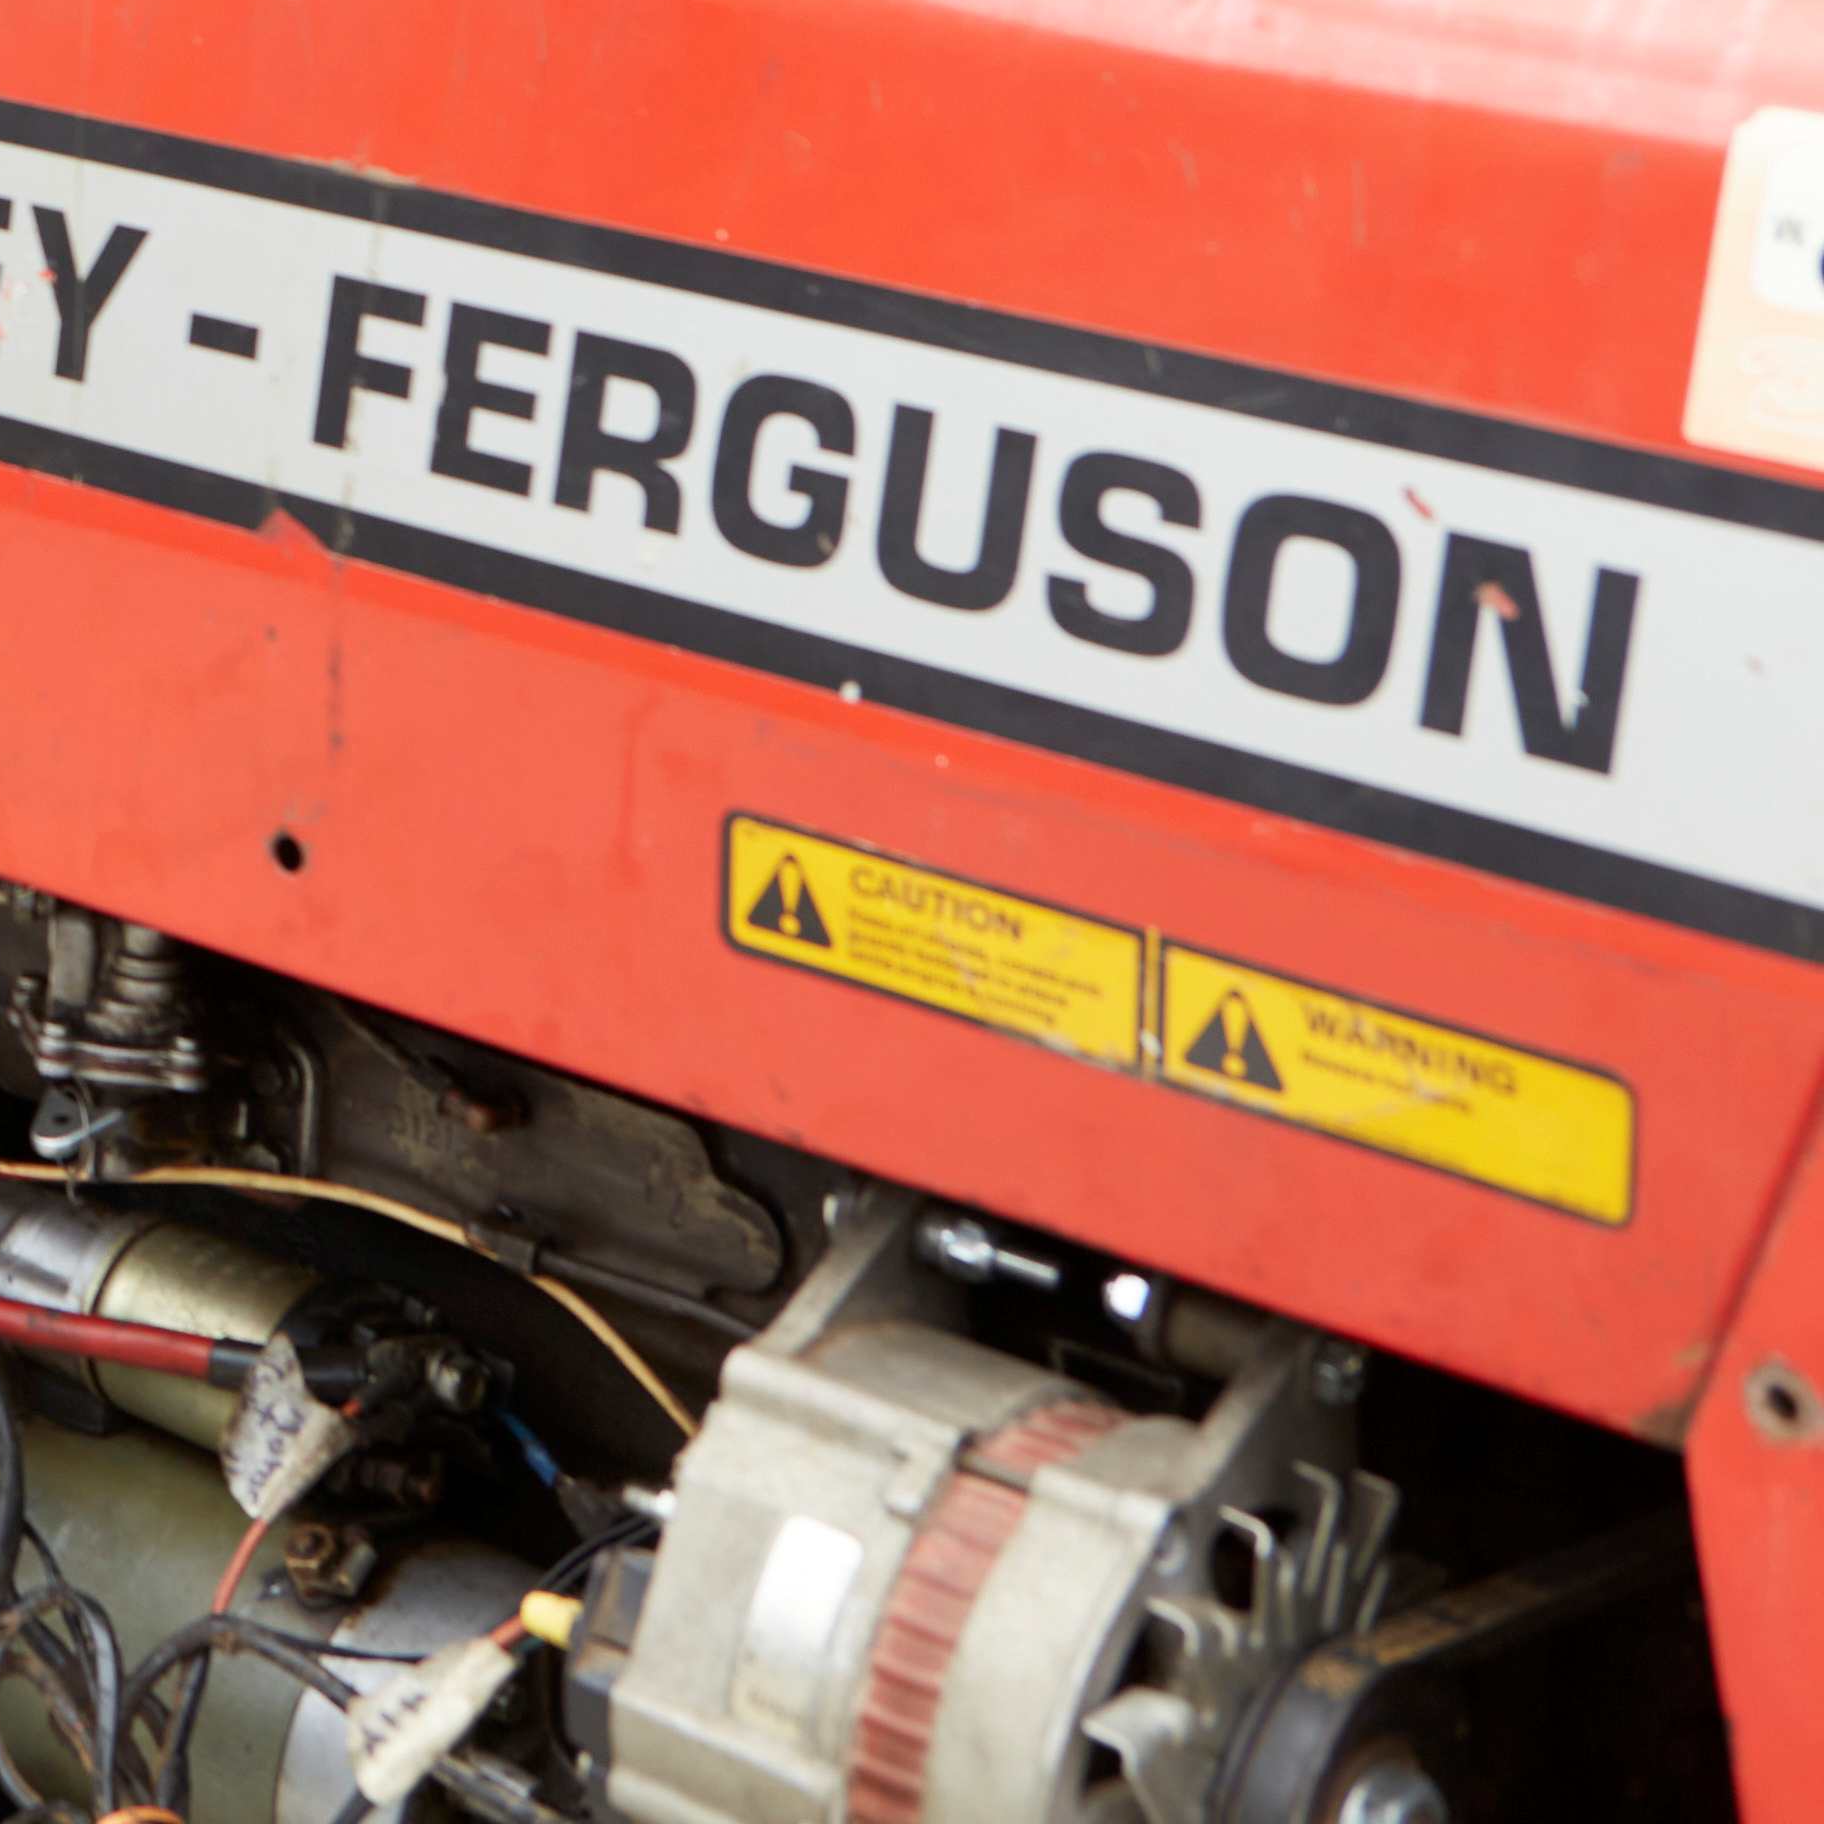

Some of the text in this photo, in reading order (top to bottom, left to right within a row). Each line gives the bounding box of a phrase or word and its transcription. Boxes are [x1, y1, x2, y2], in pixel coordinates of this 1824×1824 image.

[312, 271, 1644, 778] FERGUSON
[848, 862, 1024, 940] CAUTION
[1300, 1000, 1518, 1096] WARNING
